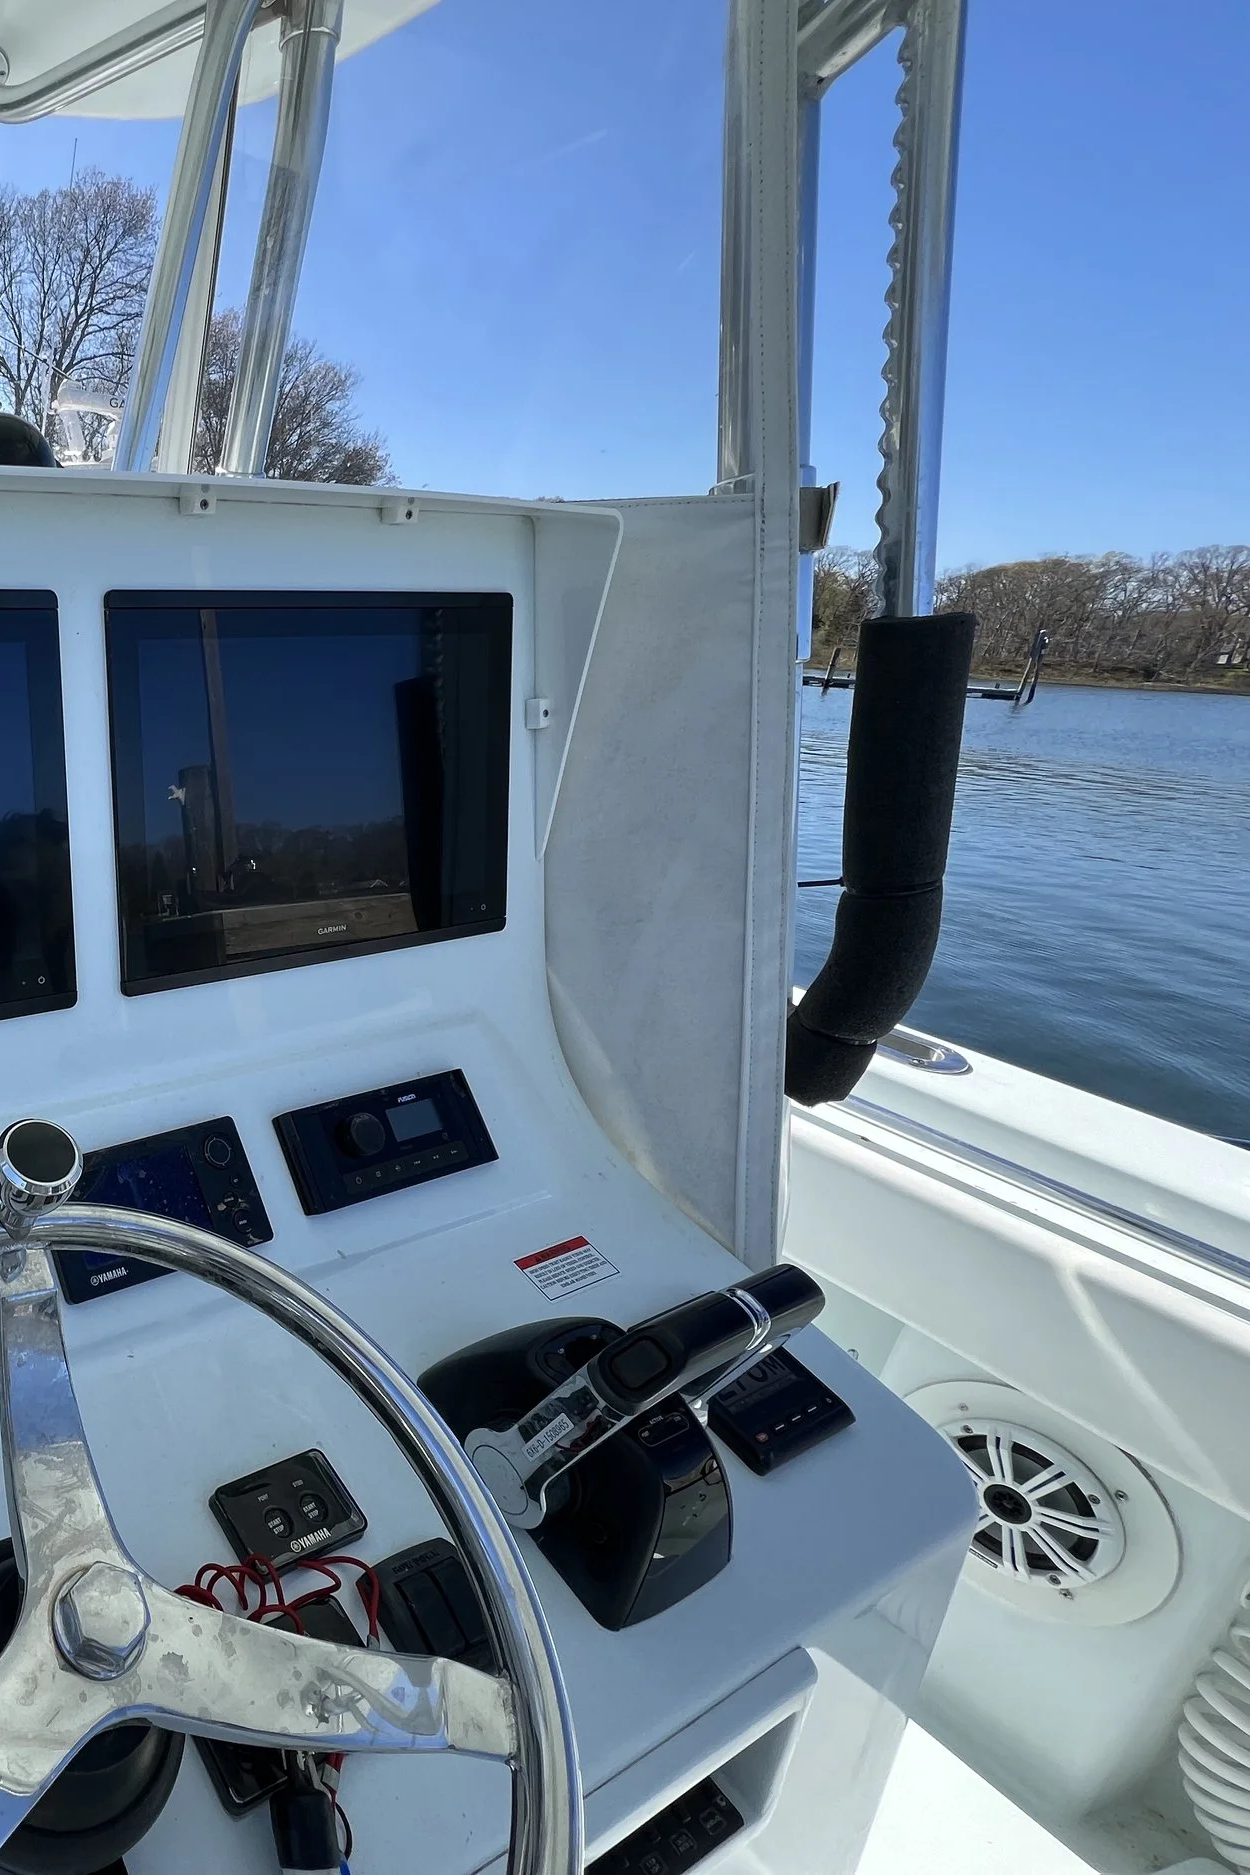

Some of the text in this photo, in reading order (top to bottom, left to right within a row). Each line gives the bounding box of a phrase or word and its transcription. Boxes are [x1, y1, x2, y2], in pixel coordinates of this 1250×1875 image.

[317, 924, 347, 935] GARMIN
[98, 1266, 128, 1284] YAMAHA
[257, 1493, 269, 1503] PORT
[302, 1502, 317, 1513] START
[308, 1509, 319, 1519] STOP
[268, 1517, 282, 1529] START
[273, 1524, 285, 1535] STOP
[299, 1527, 332, 1549] YAMAHA
